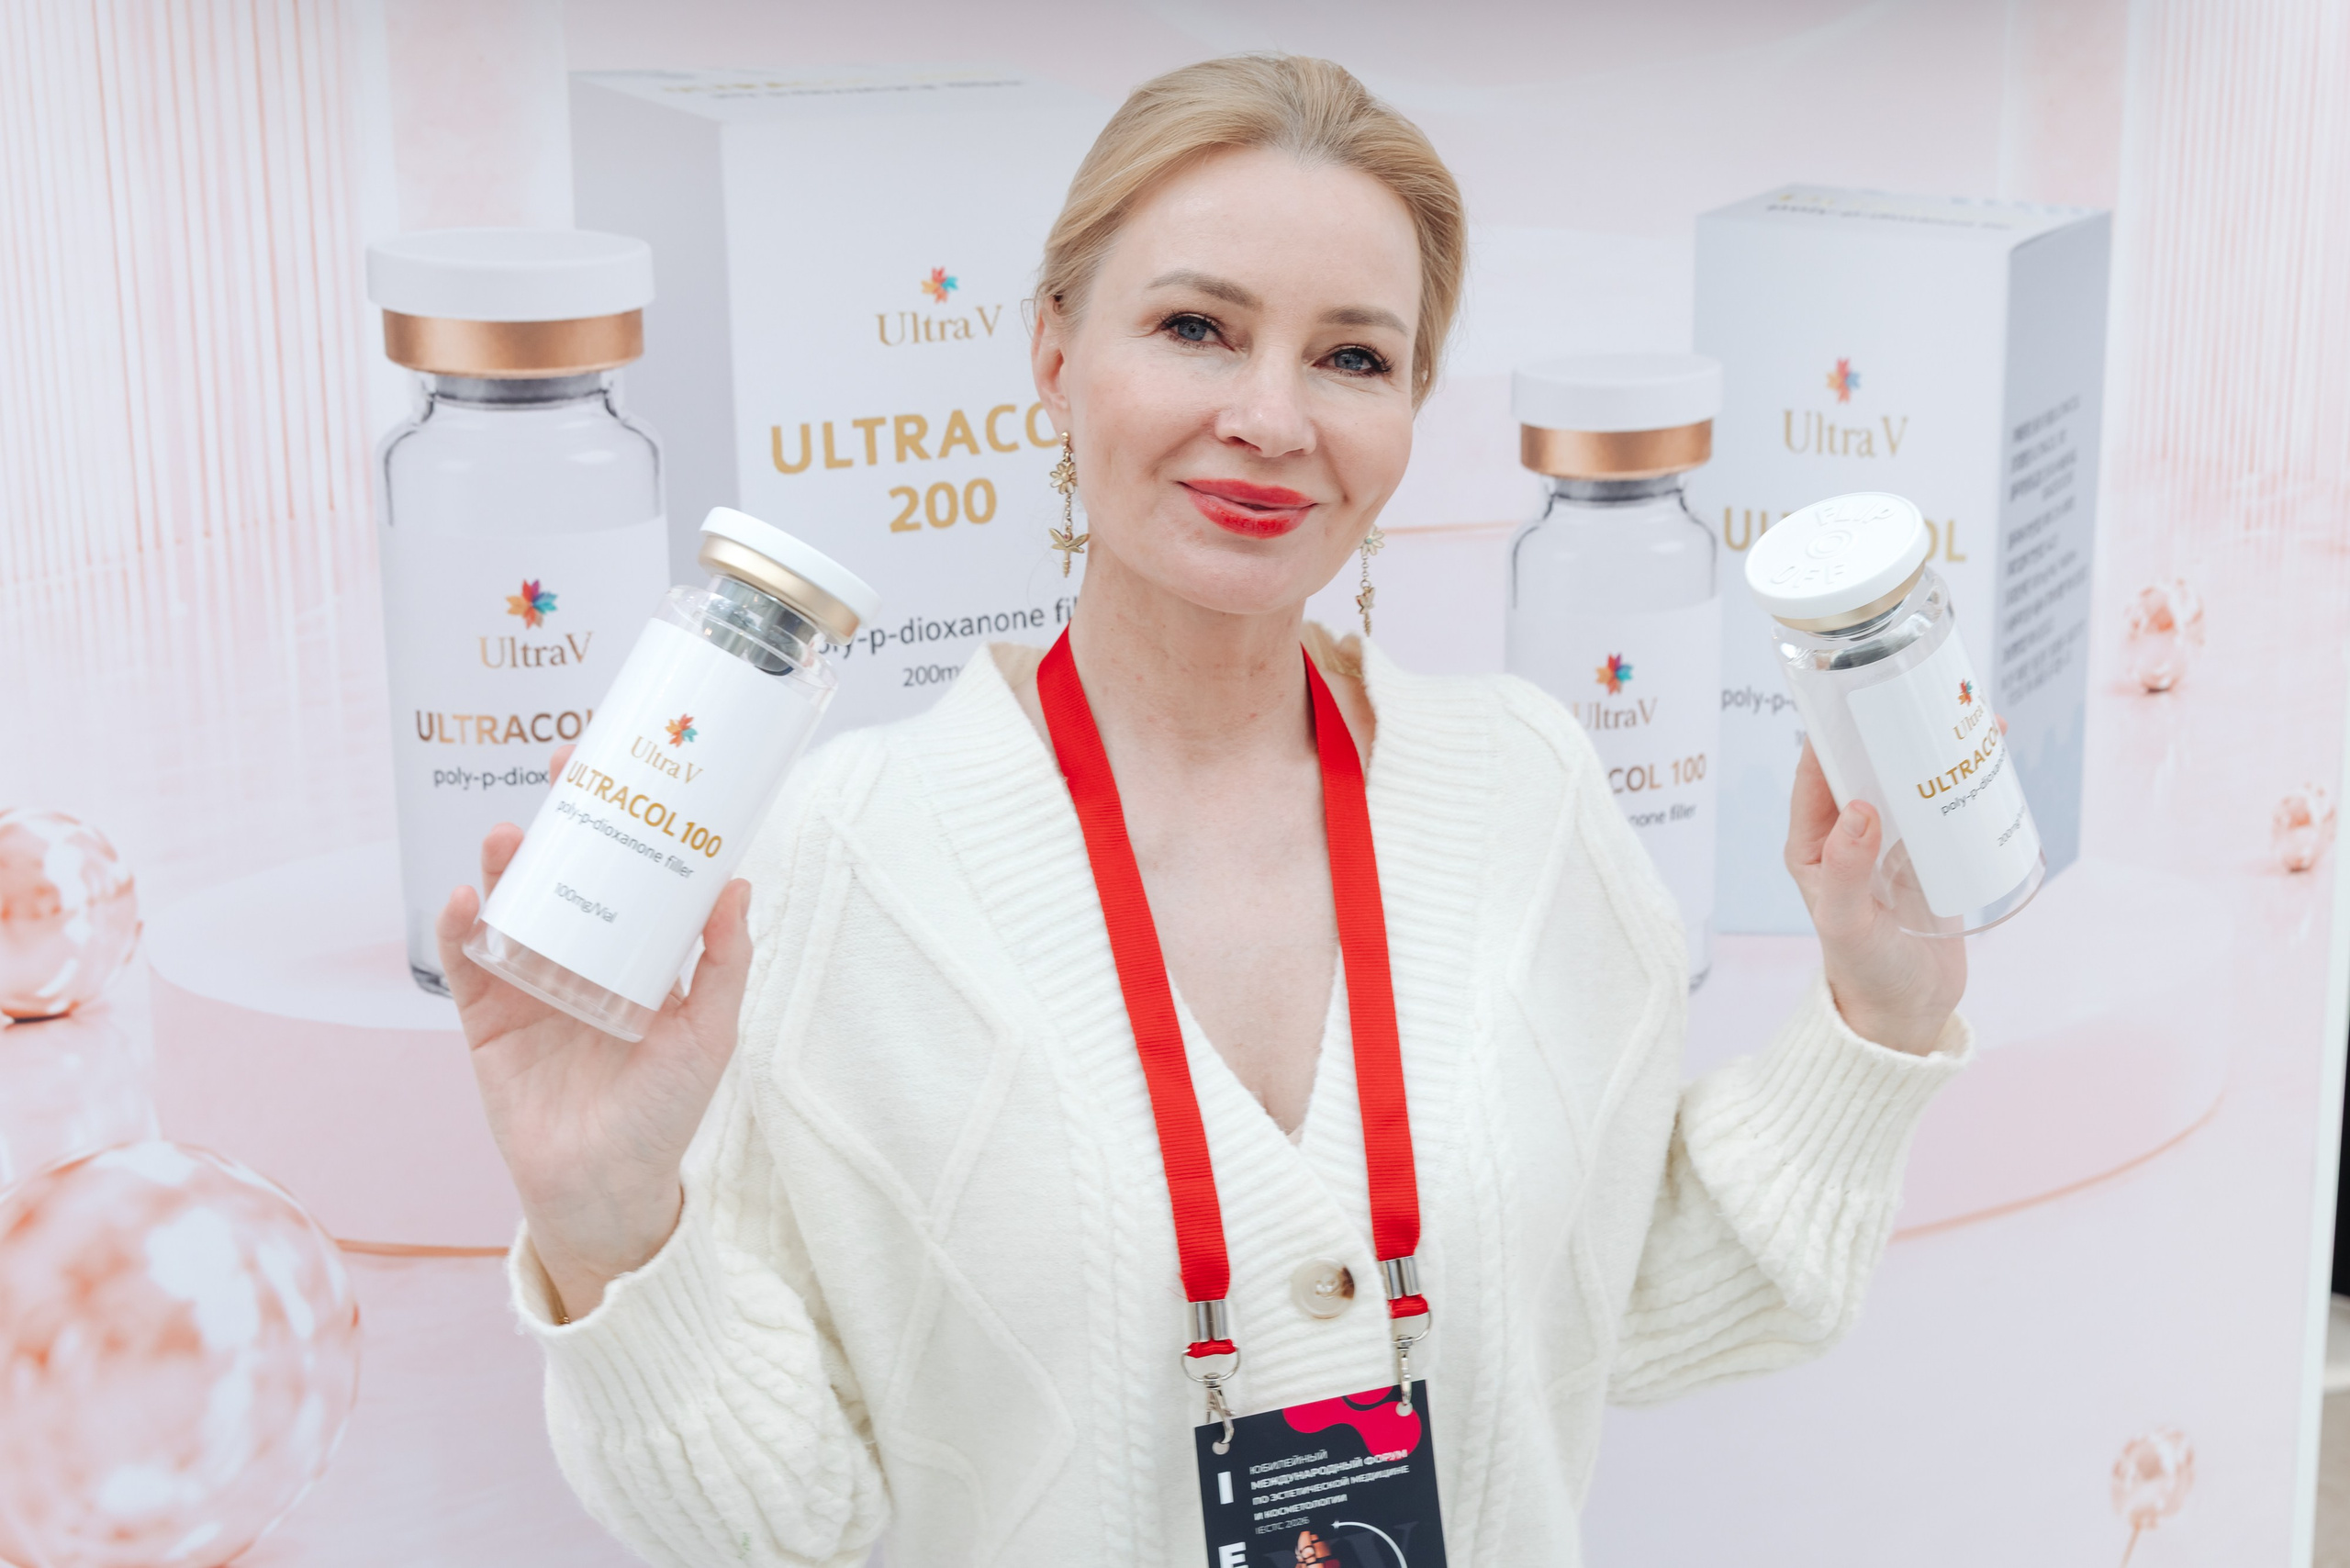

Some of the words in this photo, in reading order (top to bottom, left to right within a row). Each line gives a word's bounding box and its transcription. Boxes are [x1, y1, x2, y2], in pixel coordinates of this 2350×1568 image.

[770, 401, 1060, 475] ULTRACO
[888, 477, 998, 533] 200
[902, 664, 965, 688] 200m
[416, 709, 593, 745] ULTRACO
[433, 766, 550, 790] poly-p-diox
[1671, 753, 1707, 786] 100
[566, 760, 677, 837] ULTRACOL
[680, 821, 722, 858] 100
[555, 800, 664, 864] poly-p-dioxanone
[664, 854, 695, 879] filler
[1249, 1449, 1328, 1474] ЮБИЛЕЙНЫЙ
[1250, 1457, 1363, 1490] МЕЖДУНАРОДНЫЙ
[1363, 1449, 1408, 1466] ФОРУМ
[1252, 1495, 1270, 1506] ПО
[1270, 1475, 1350, 1502] ЭСТЕТИЧЕСКОЙ
[1350, 1464, 1410, 1484] МЕДИЦИНЕ
[1263, 1494, 1348, 1519] КОСМЕТОЛОГИИ
